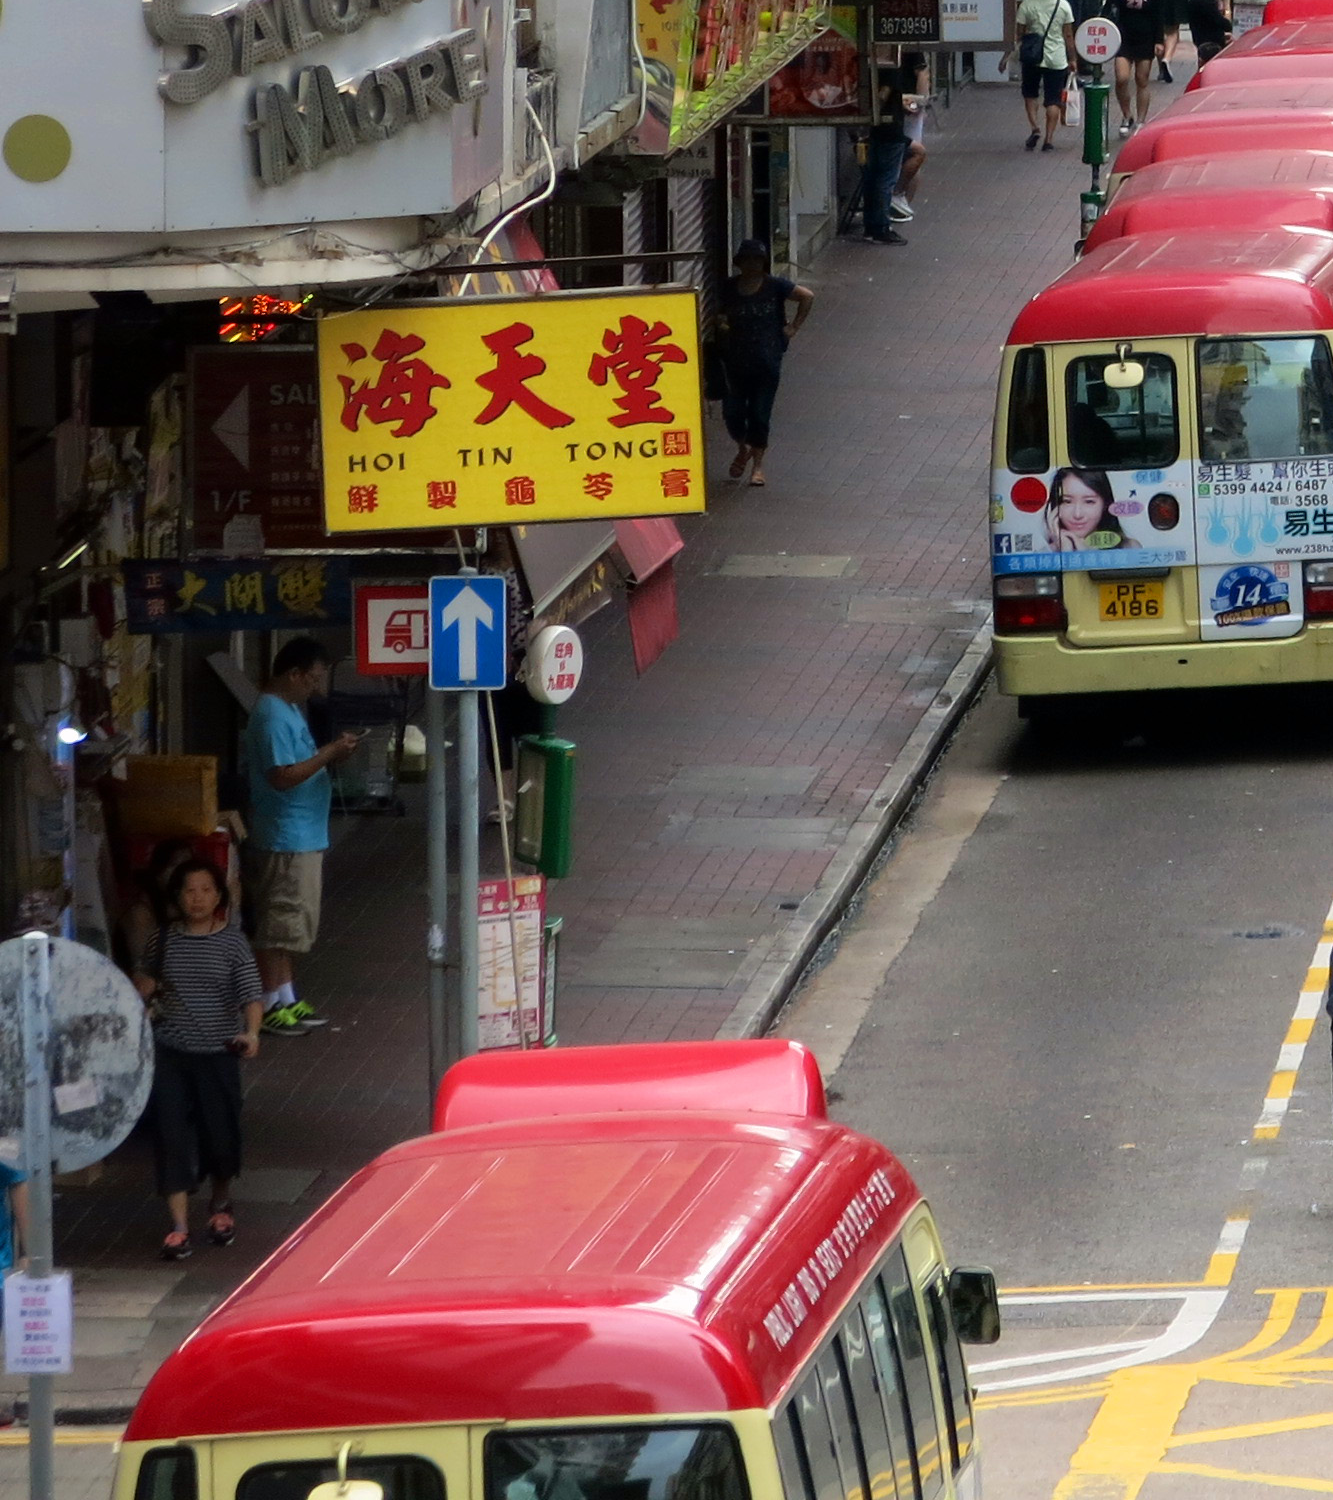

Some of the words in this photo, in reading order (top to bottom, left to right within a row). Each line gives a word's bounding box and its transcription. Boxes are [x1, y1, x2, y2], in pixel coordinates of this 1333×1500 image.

[245, 28, 488, 188] MORE
[337, 316, 688, 438] 海天堂
[348, 452, 407, 474] HOI
[458, 446, 514, 467] TIN
[565, 439, 659, 463] TONG
[348, 469, 690, 514] 鮮製龜苓膏
[1213, 484, 1246, 496] 5399
[1250, 482, 1283, 493] 4424
[1295, 479, 1326, 491] 6487
[1295, 495, 1328, 507] 3568
[1117, 584, 1146, 601] PF
[1106, 600, 1159, 617] 4186
